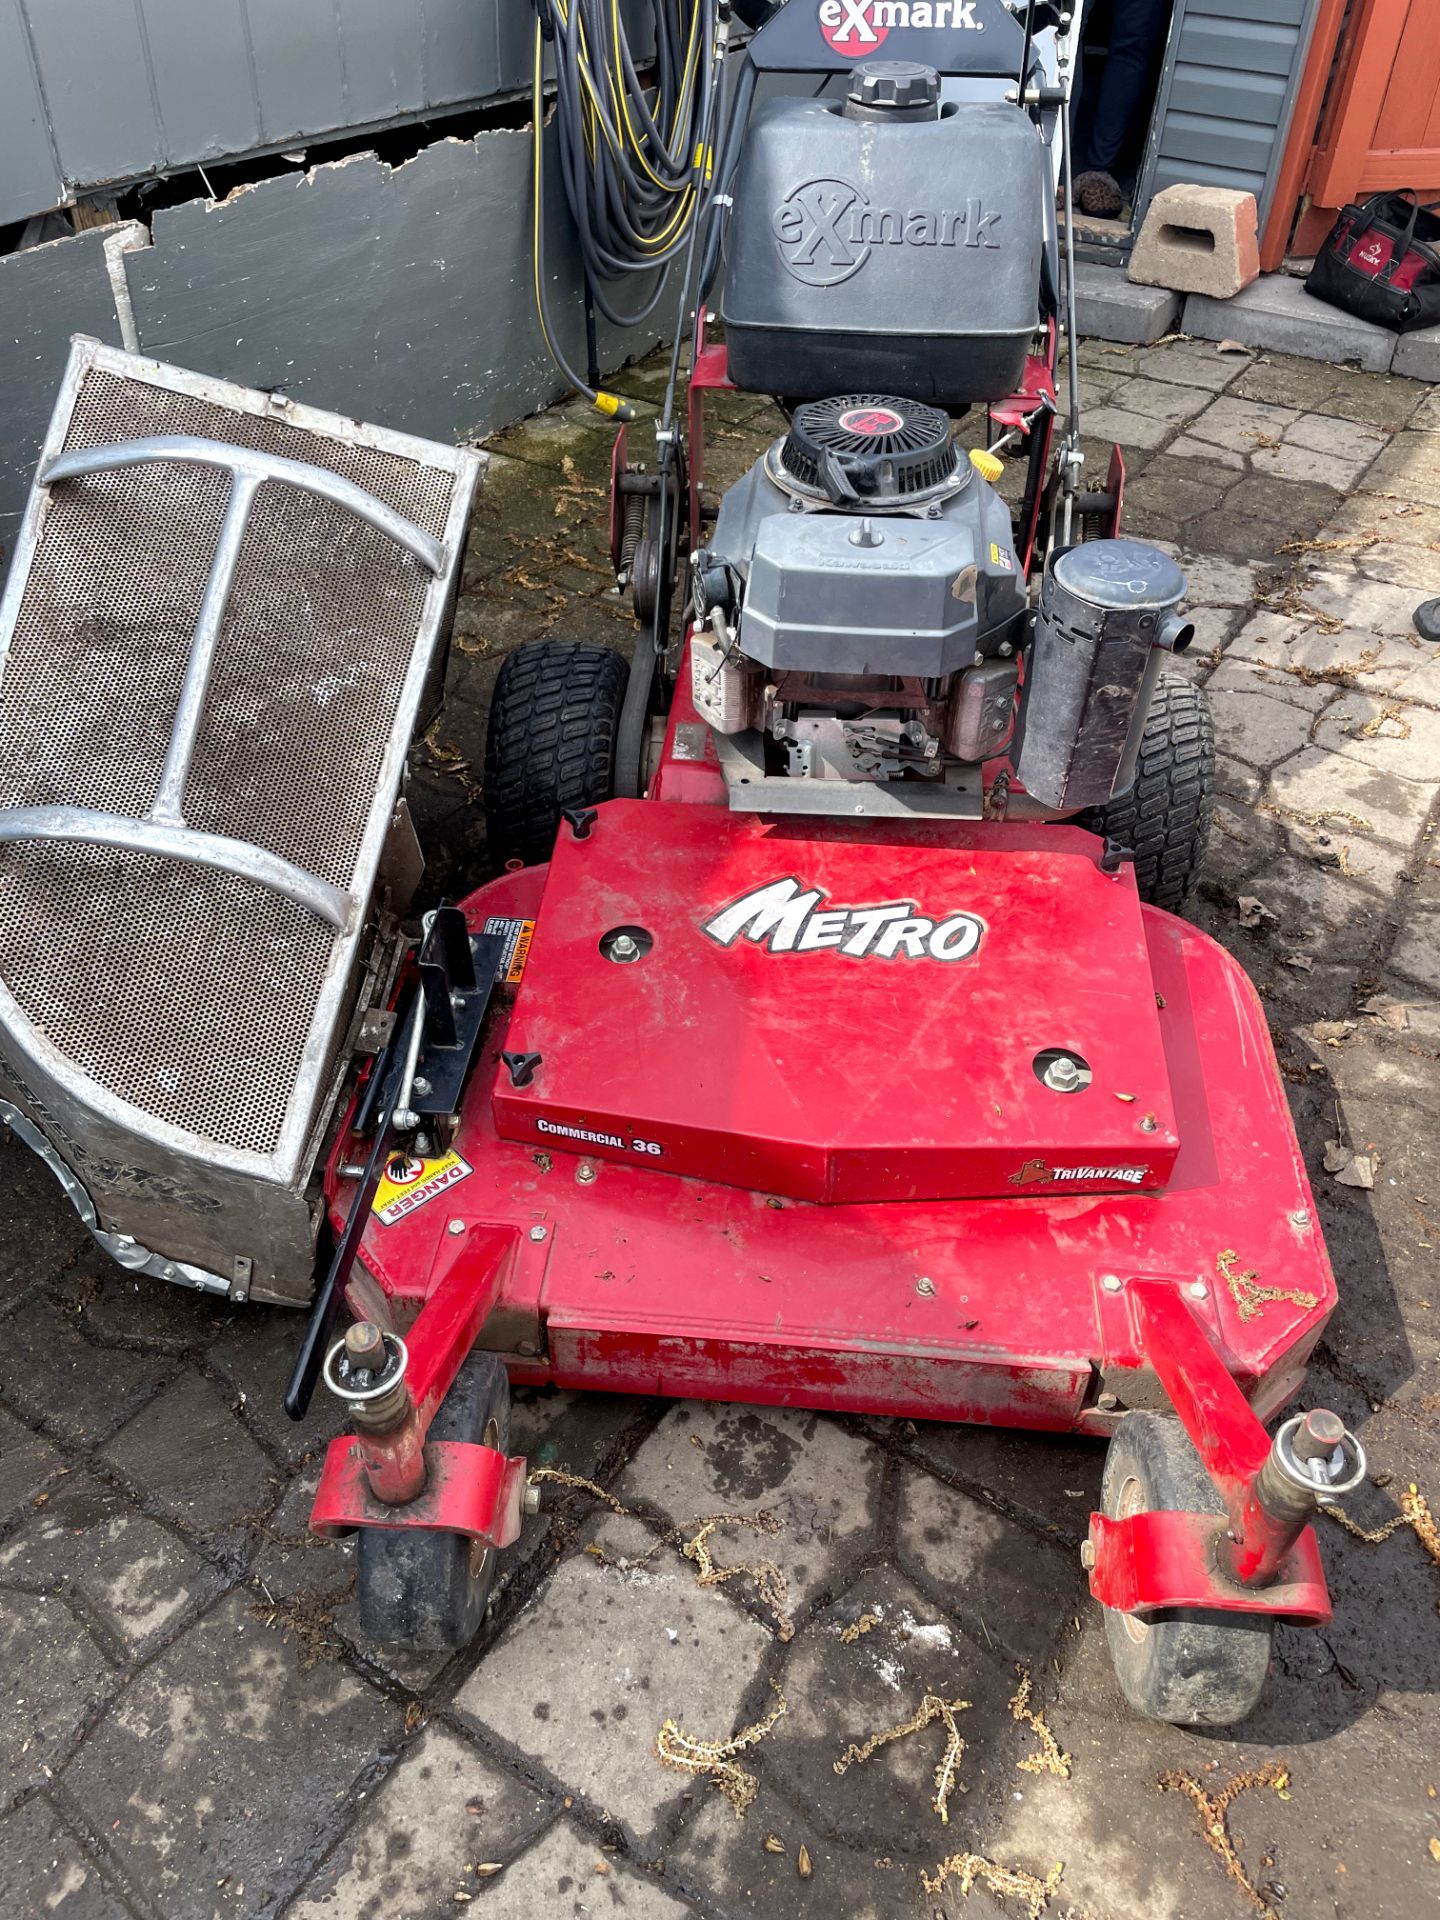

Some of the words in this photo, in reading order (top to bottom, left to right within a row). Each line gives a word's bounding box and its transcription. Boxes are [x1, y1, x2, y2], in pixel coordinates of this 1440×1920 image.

[703, 877, 982, 961] METRO
[510, 935, 530, 976] WARNING
[537, 1119, 625, 1148] COMMERCIAL
[632, 1139, 661, 1155] 36
[387, 1166, 464, 1216] DANGER
[396, 1188, 410, 1199] FEET
[420, 1169, 440, 1182] HANDS
[1053, 1168, 1144, 1184] TRIVANTAGE
